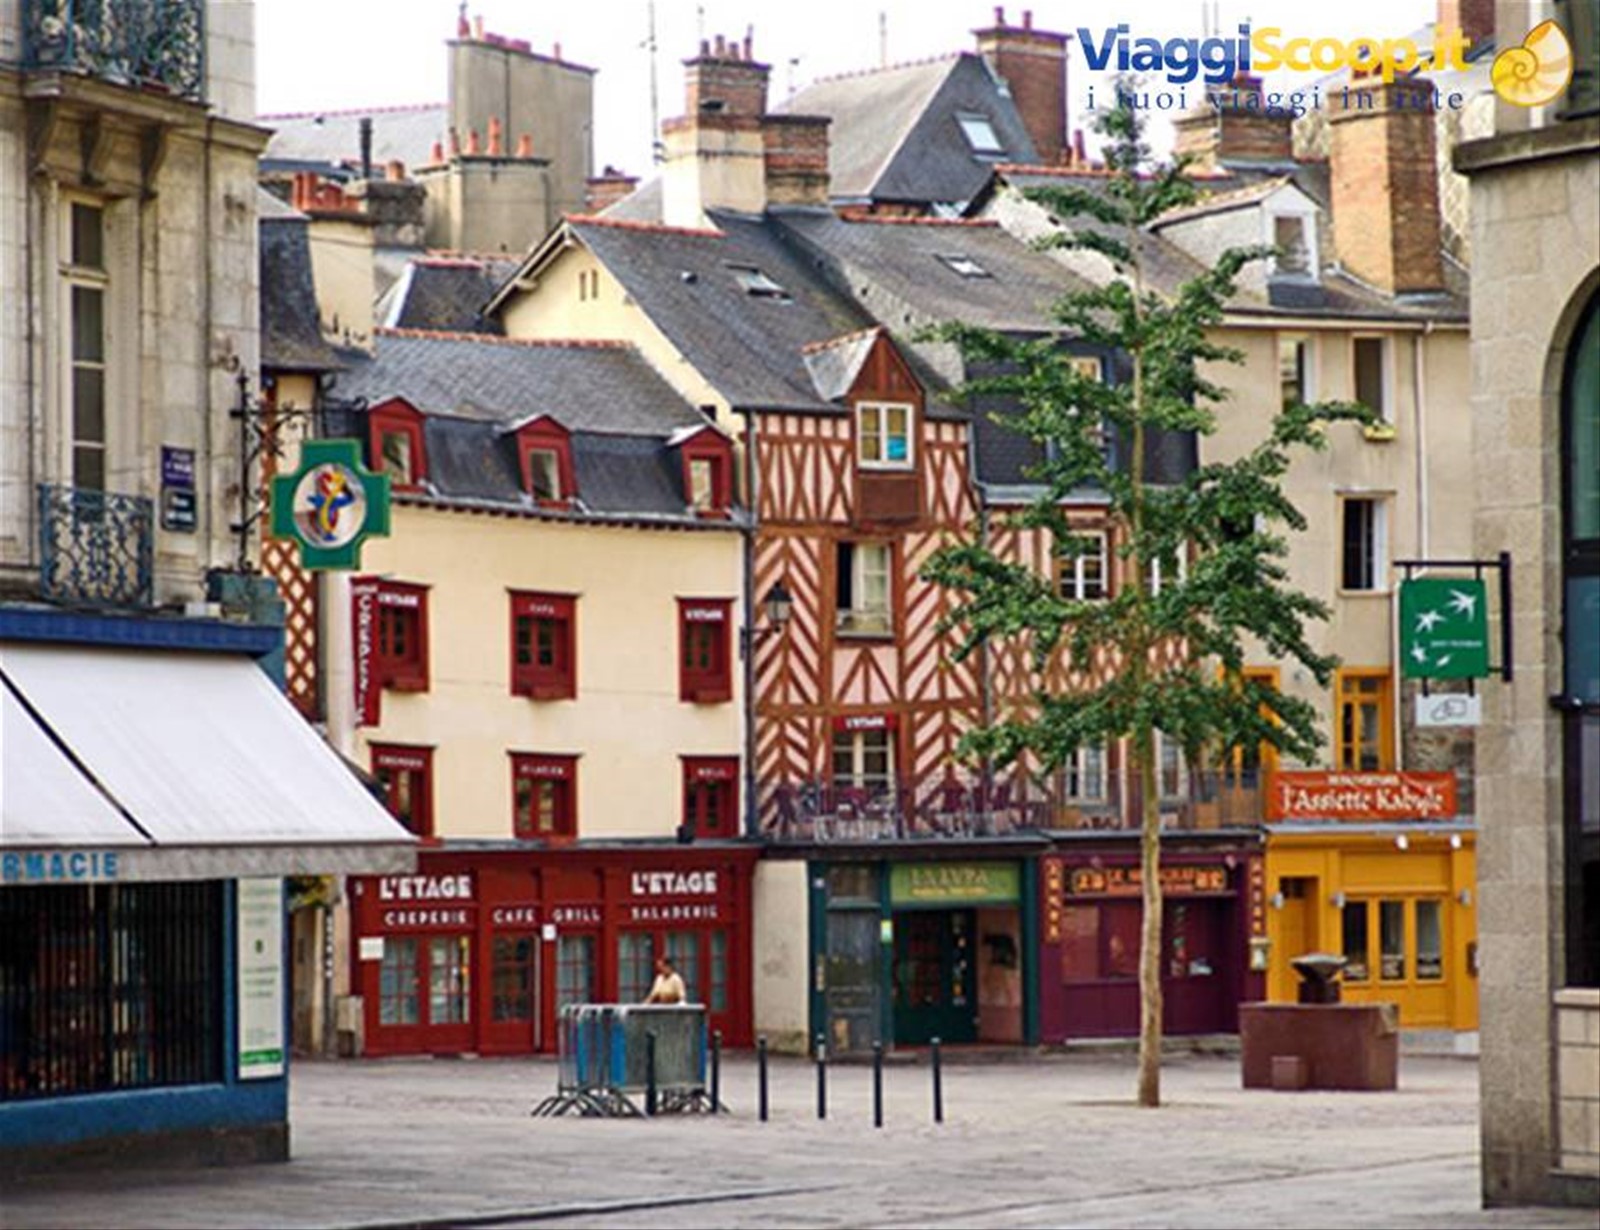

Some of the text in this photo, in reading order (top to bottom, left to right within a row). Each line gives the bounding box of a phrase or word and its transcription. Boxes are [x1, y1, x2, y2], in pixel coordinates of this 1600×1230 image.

[379, 875, 471, 900] L'ETAGE
[631, 871, 717, 895] L'ETAGE
[384, 909, 468, 927] CREPERIE
[493, 908, 601, 924] CAFE GRILL
